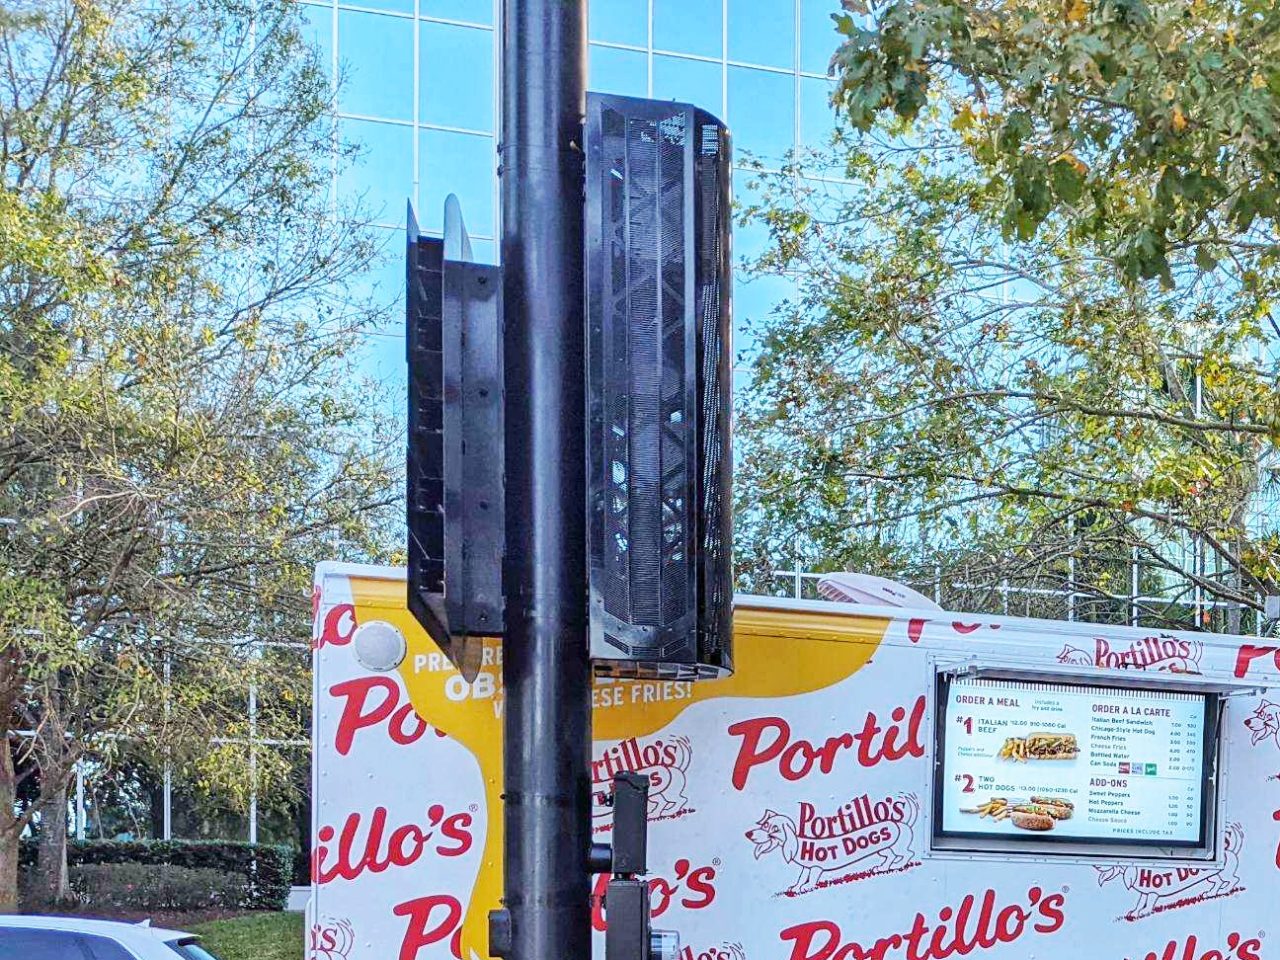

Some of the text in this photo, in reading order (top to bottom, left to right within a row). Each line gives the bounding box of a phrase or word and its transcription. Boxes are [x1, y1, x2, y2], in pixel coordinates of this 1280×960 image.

[631, 680, 692, 704] FRIES!
[956, 695, 1021, 708] ORDER A MEAL
[1092, 704, 1171, 718] ORDER A LA CARTE
[978, 718, 1008, 727] ITALIAN
[978, 726, 998, 734] BEEF
[1091, 725, 1131, 734] Chicago-Style
[1090, 751, 1112, 759] Bottled
[978, 775, 995, 783] TWO
[1089, 778, 1128, 788] ADD-ONS
[978, 783, 993, 791] HOT
[1107, 791, 1131, 799] Peppers
[799, 794, 906, 839] Portillo's
[801, 826, 892, 863] HOT DOGS
[1139, 868, 1172, 889] HOT
